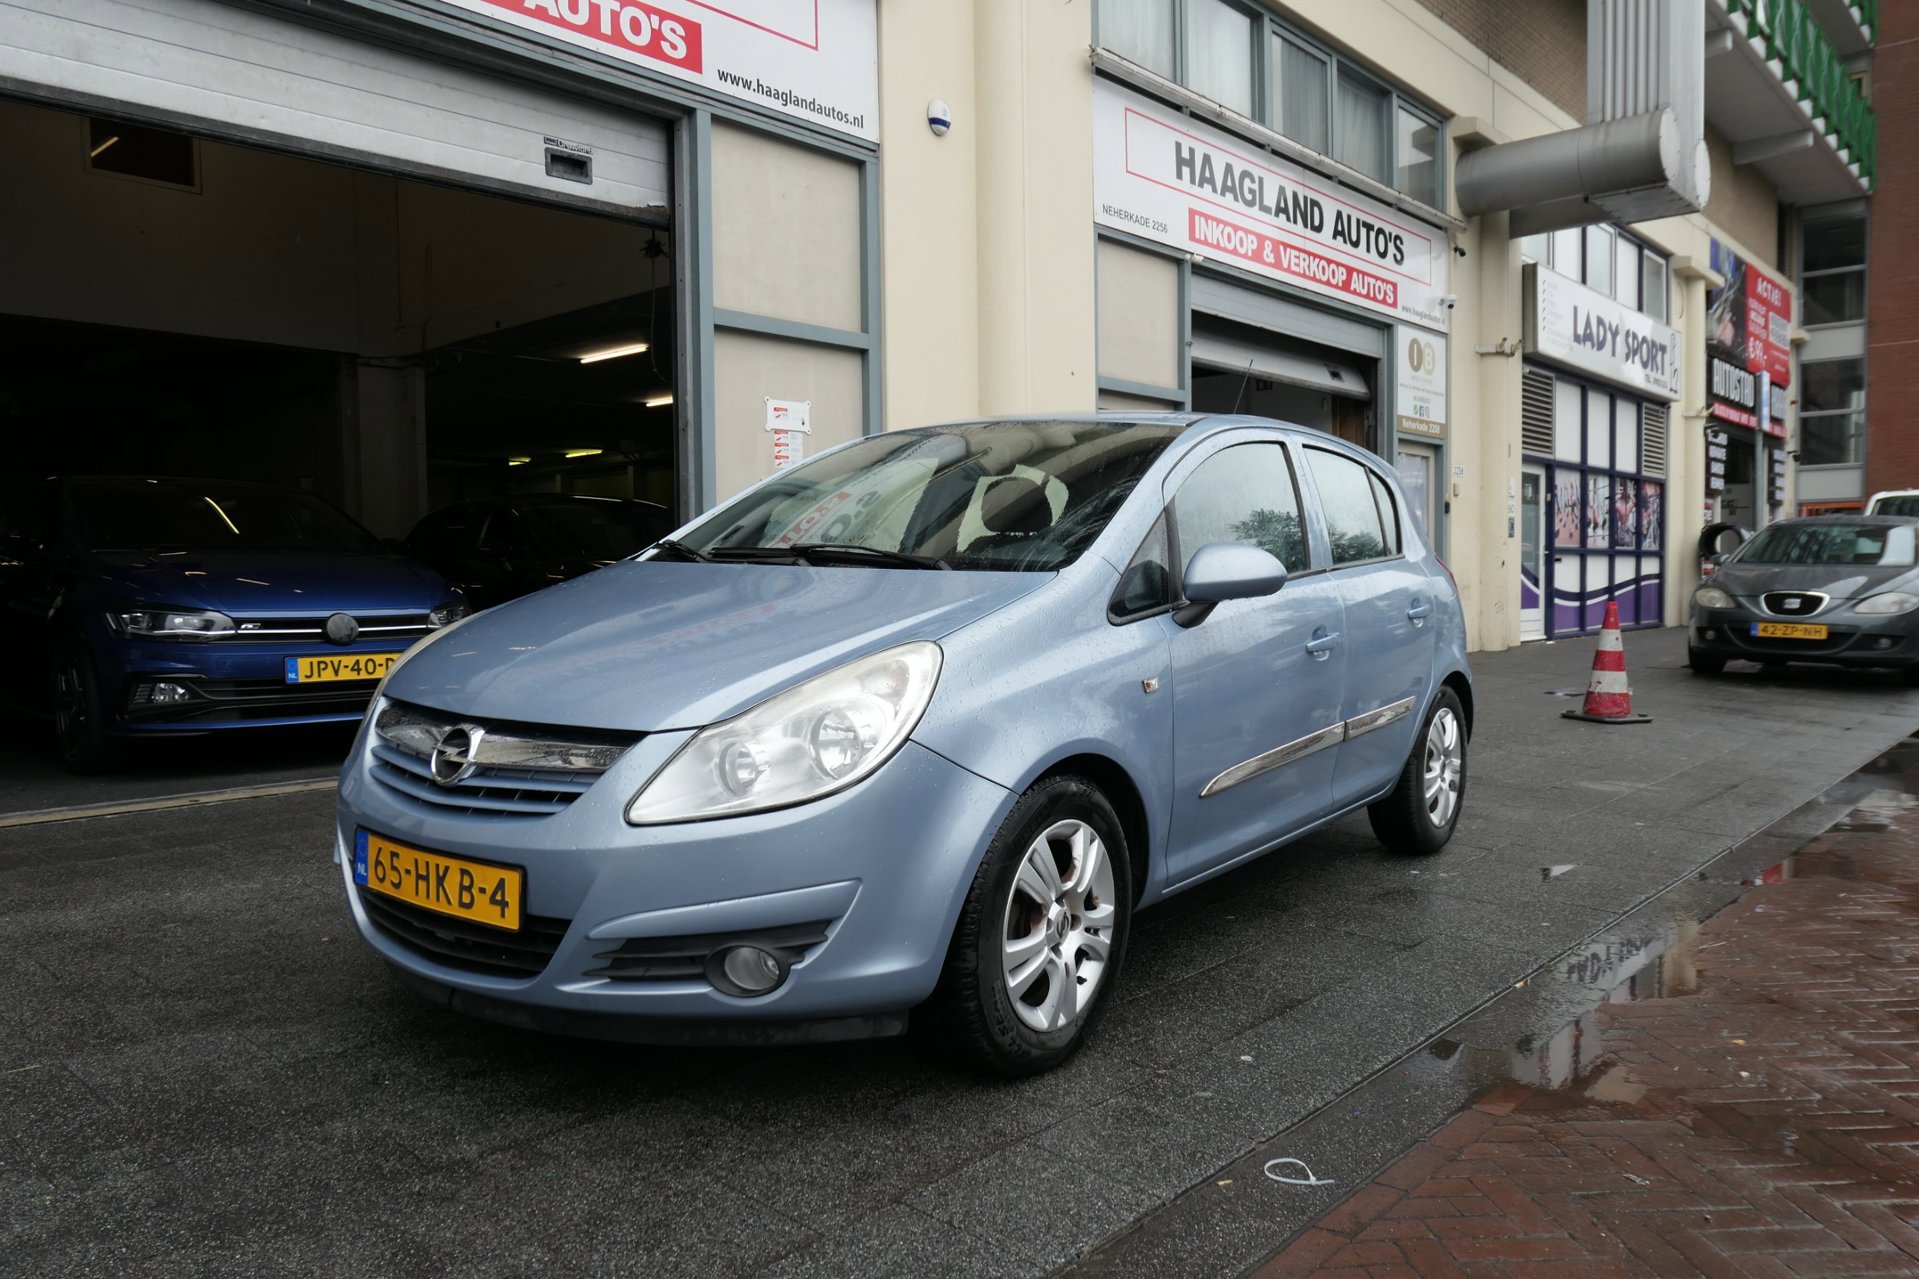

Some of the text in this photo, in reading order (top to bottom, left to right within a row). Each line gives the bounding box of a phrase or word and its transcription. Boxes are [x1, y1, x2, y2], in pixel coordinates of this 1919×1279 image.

[717, 68, 864, 129] www.haaglandautos.nl
[1102, 203, 1168, 234] NEHERKADE 2256
[1175, 140, 1405, 266] HAAGLAND AUTO'S
[1194, 214, 1394, 304] INKOOP & VERKOOP AUTO'S
[1573, 304, 1620, 358] LADY
[1624, 328, 1667, 376] SPORT
[1761, 624, 1823, 636] 42-ZP-NH
[357, 846, 510, 919] NL 65-HKB-4
